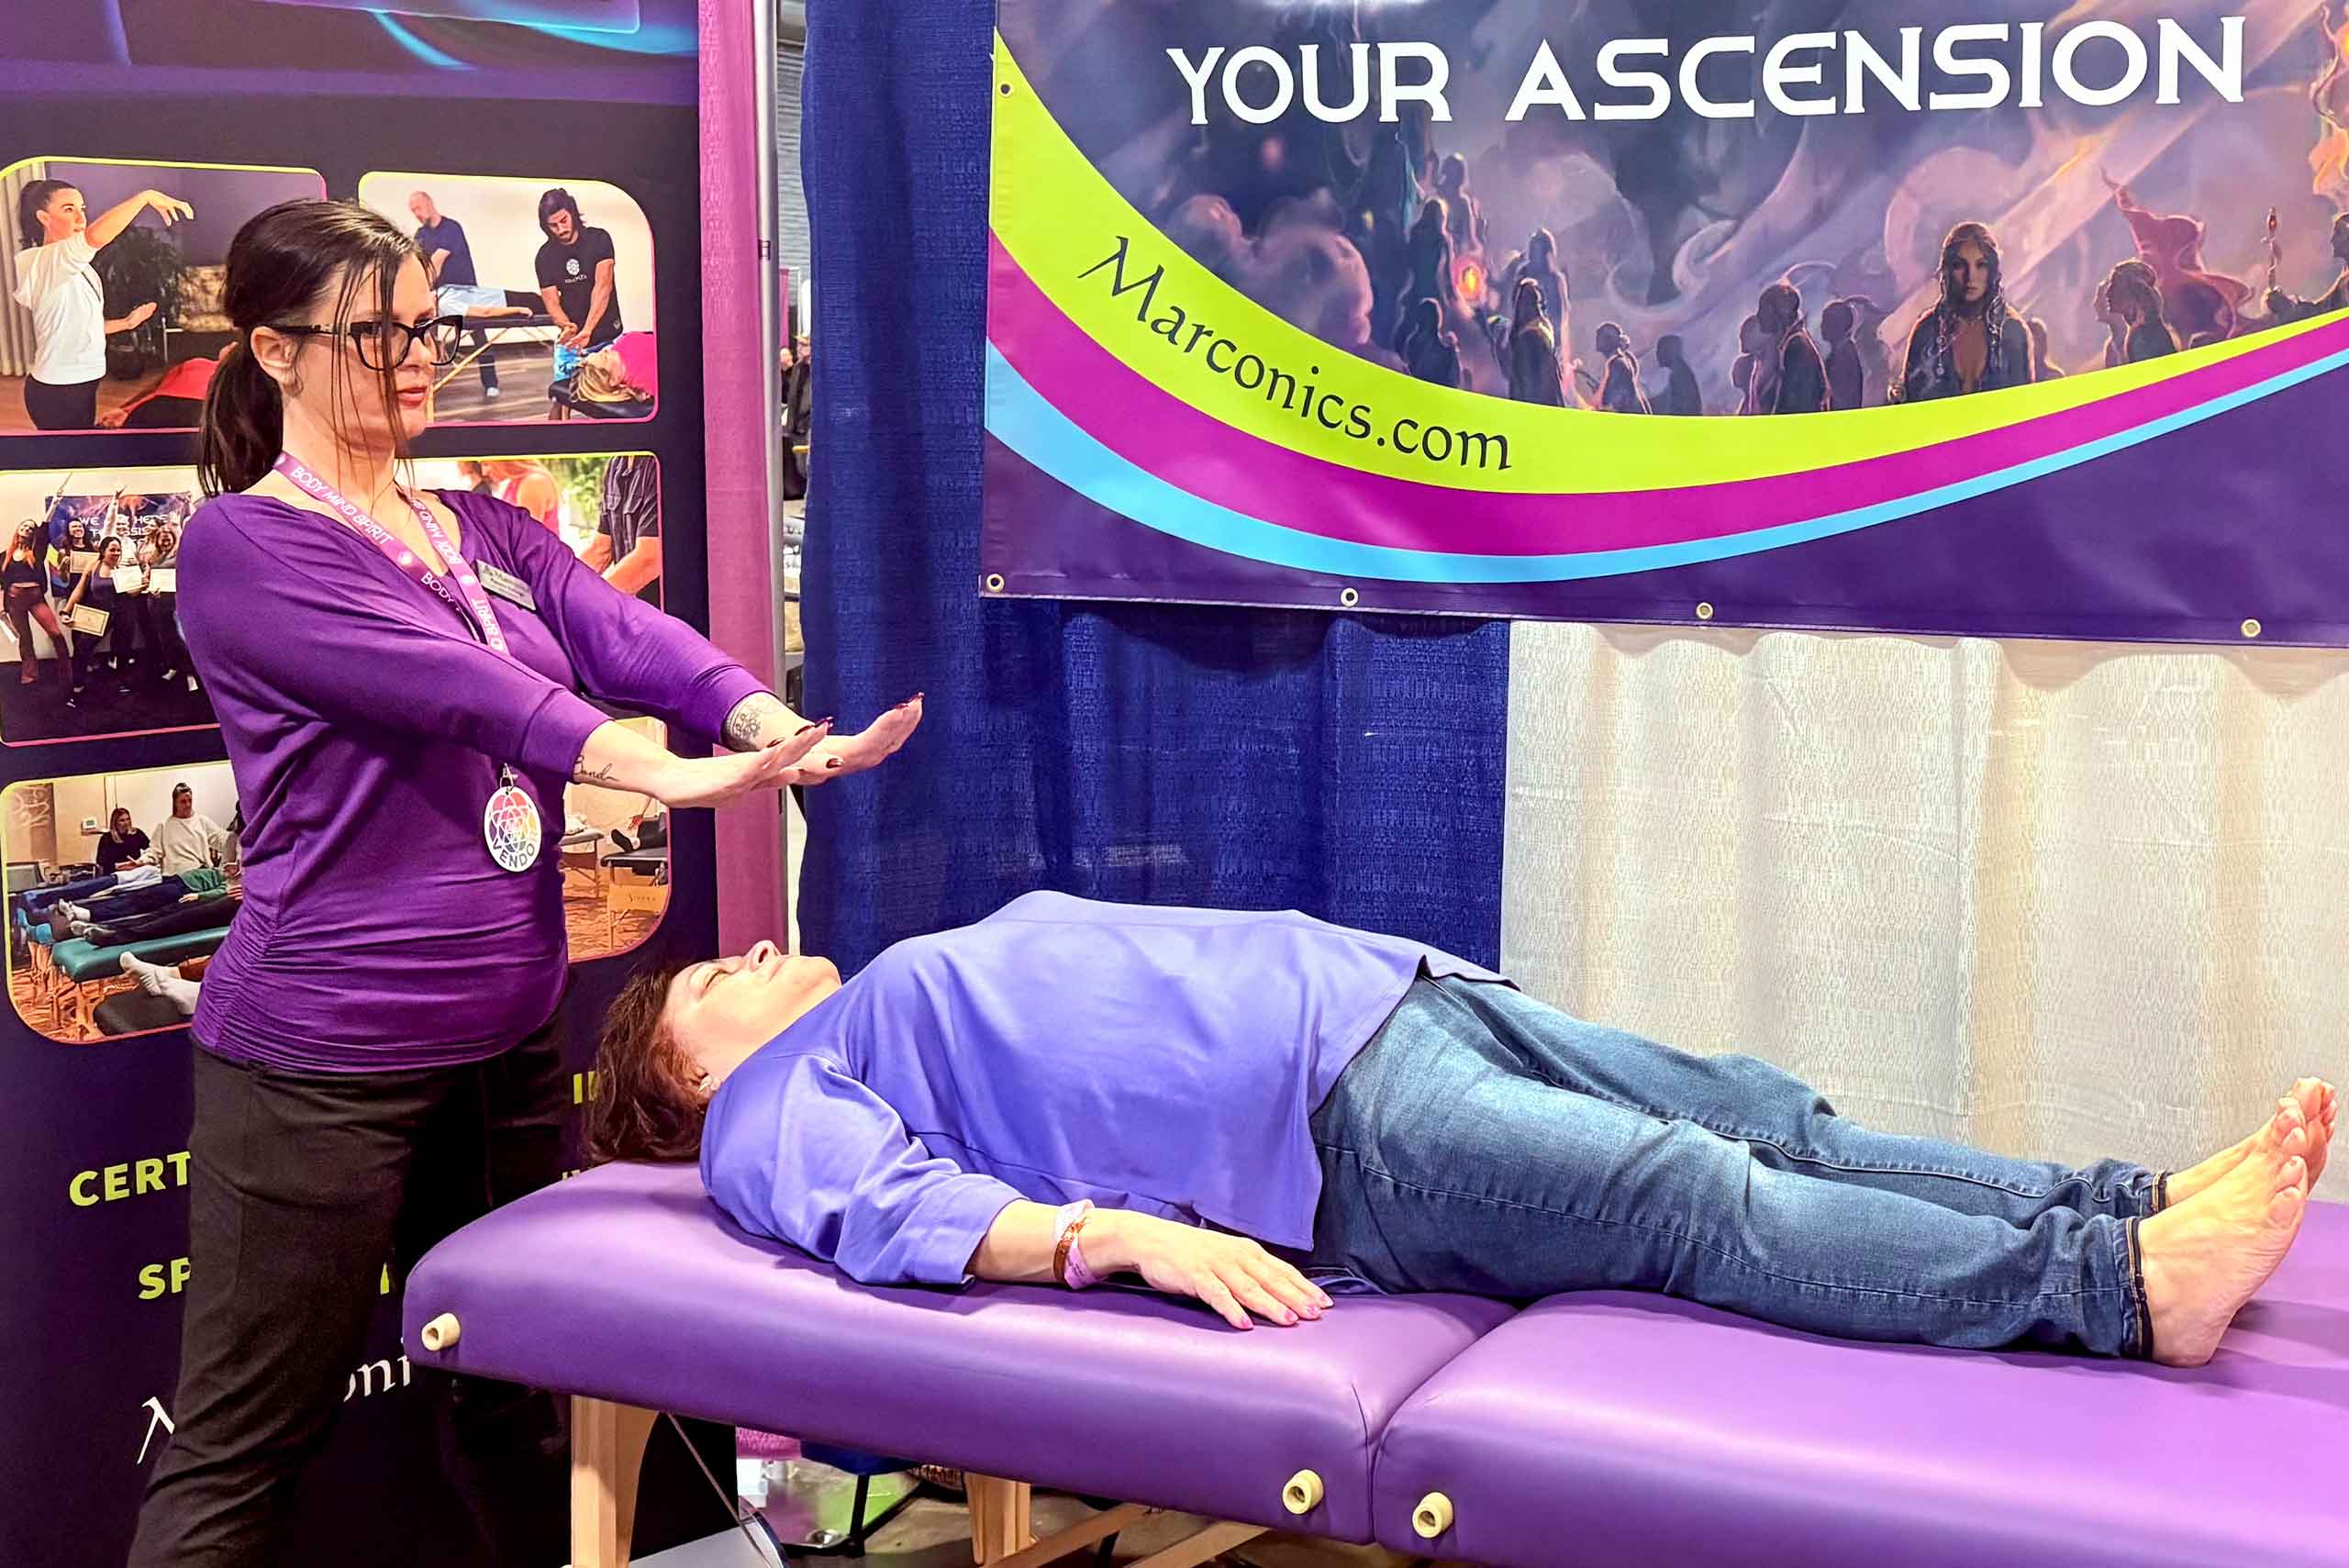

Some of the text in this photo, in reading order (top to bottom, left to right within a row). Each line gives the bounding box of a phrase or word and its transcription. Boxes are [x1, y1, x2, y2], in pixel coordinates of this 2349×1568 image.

[1166, 17, 2245, 125] YOUR ASCENSION
[1077, 236, 1512, 471] Marconics.com
[291, 465, 394, 544] BODY MIND SPIRIT
[420, 571, 454, 603] BODY
